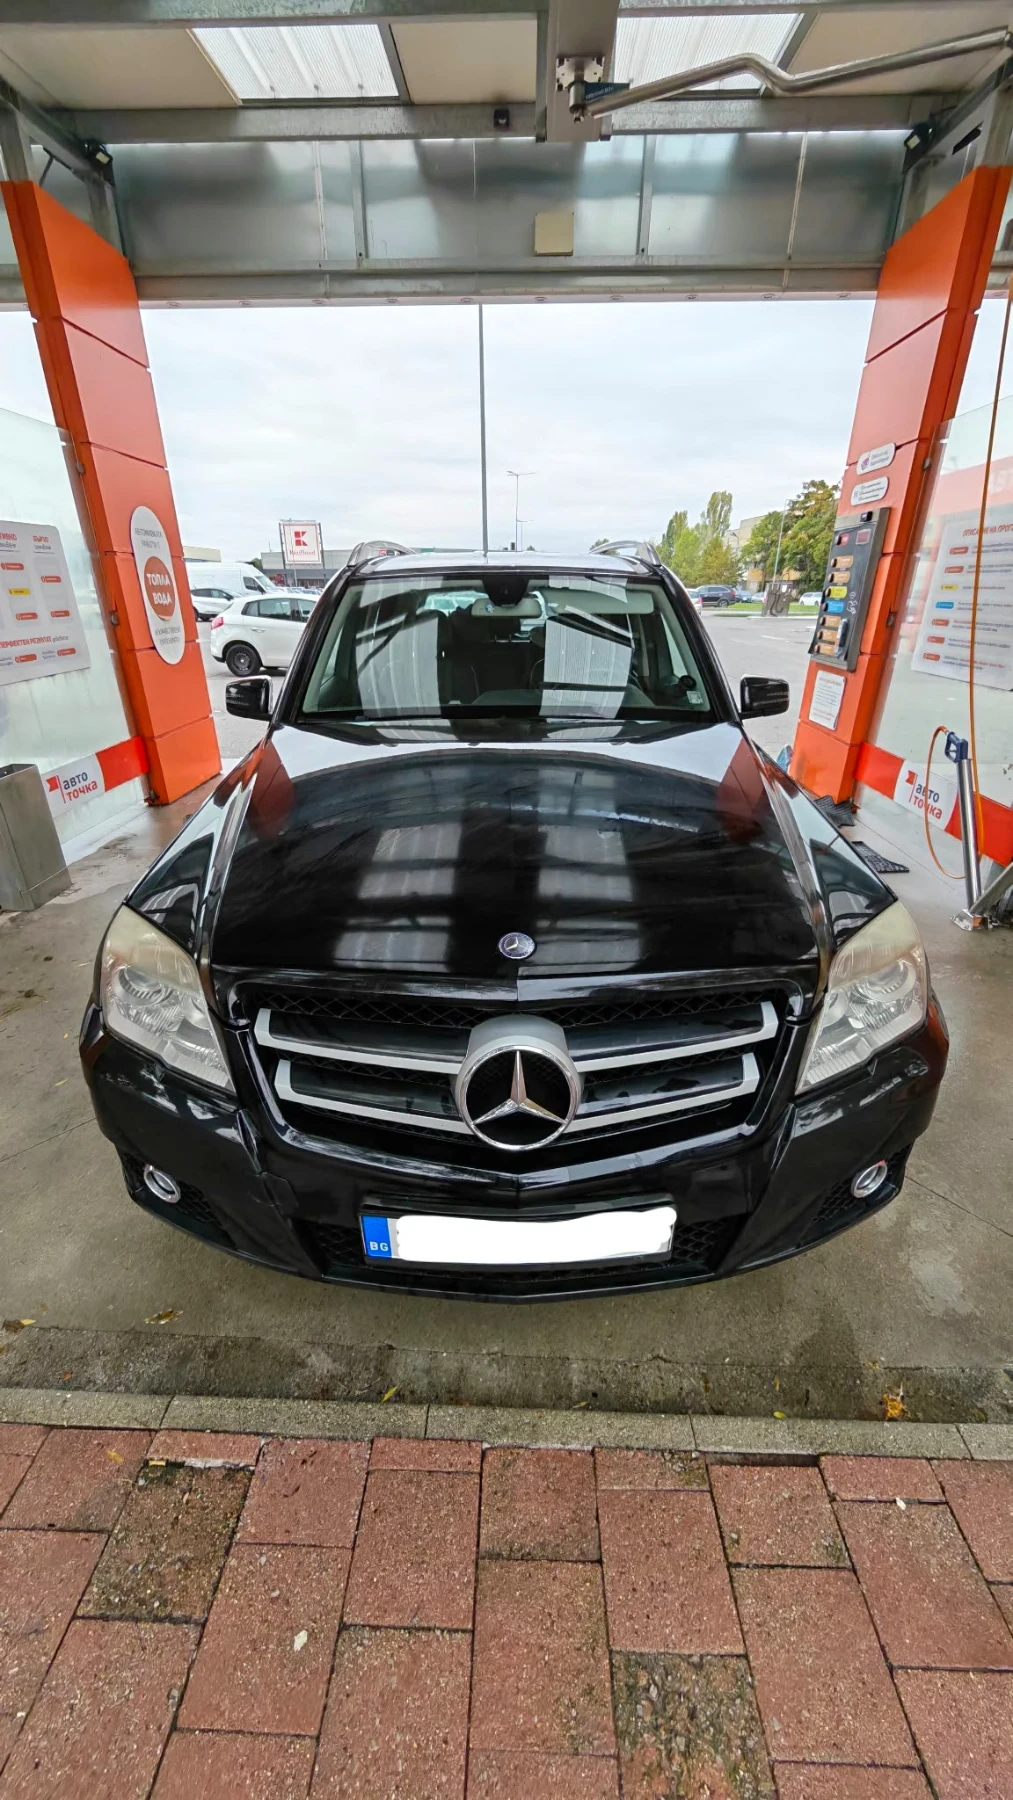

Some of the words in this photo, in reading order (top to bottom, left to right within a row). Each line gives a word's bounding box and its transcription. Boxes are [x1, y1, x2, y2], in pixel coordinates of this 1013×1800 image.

[146, 573, 171, 586] ТОПЛА
[152, 592, 173, 606] ВОДА
[63, 772, 88, 790] авто
[66, 780, 98, 801] точка
[369, 1241, 389, 1252] BG
